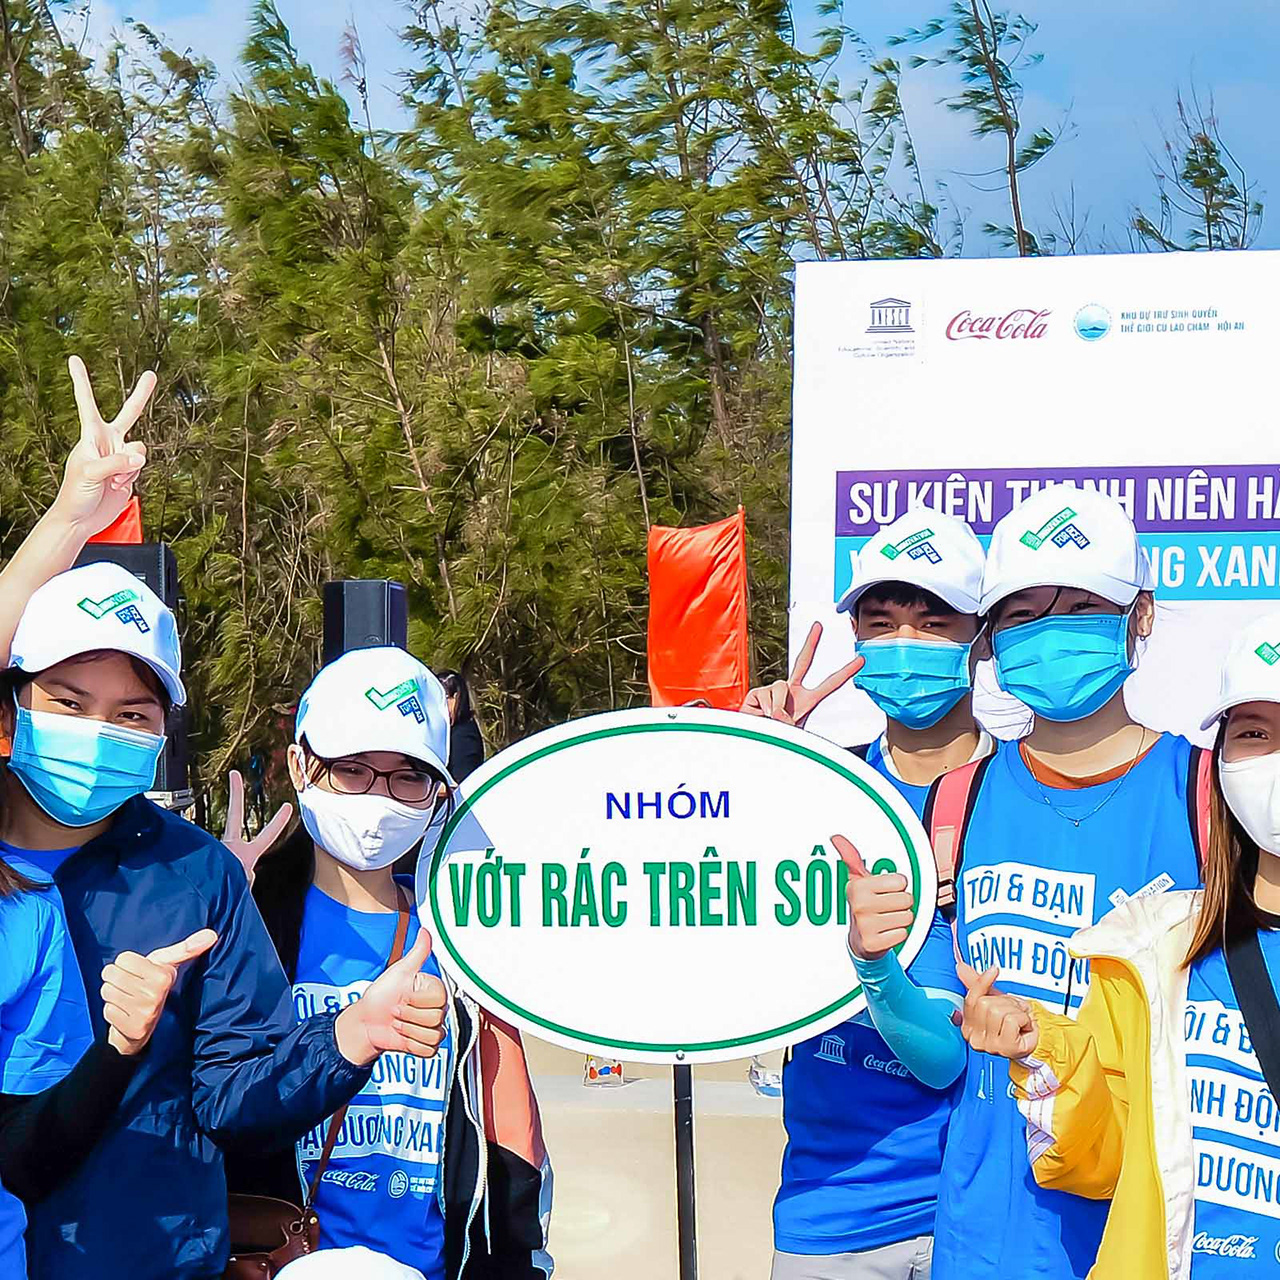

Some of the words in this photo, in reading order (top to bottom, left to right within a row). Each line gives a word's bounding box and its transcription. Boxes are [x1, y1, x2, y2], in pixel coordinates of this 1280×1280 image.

[1146, 469, 1236, 520] NIÊN
[605, 784, 731, 820] NHÓM
[449, 845, 526, 928] VỚT
[542, 847, 628, 928] RÁC
[643, 847, 757, 927] TRÊN
[967, 870, 1001, 910] TÔI
[1007, 873, 1024, 902] &
[1032, 877, 1084, 919] BẠN
[971, 933, 1023, 972] HÀNH
[1213, 1013, 1229, 1046] &
